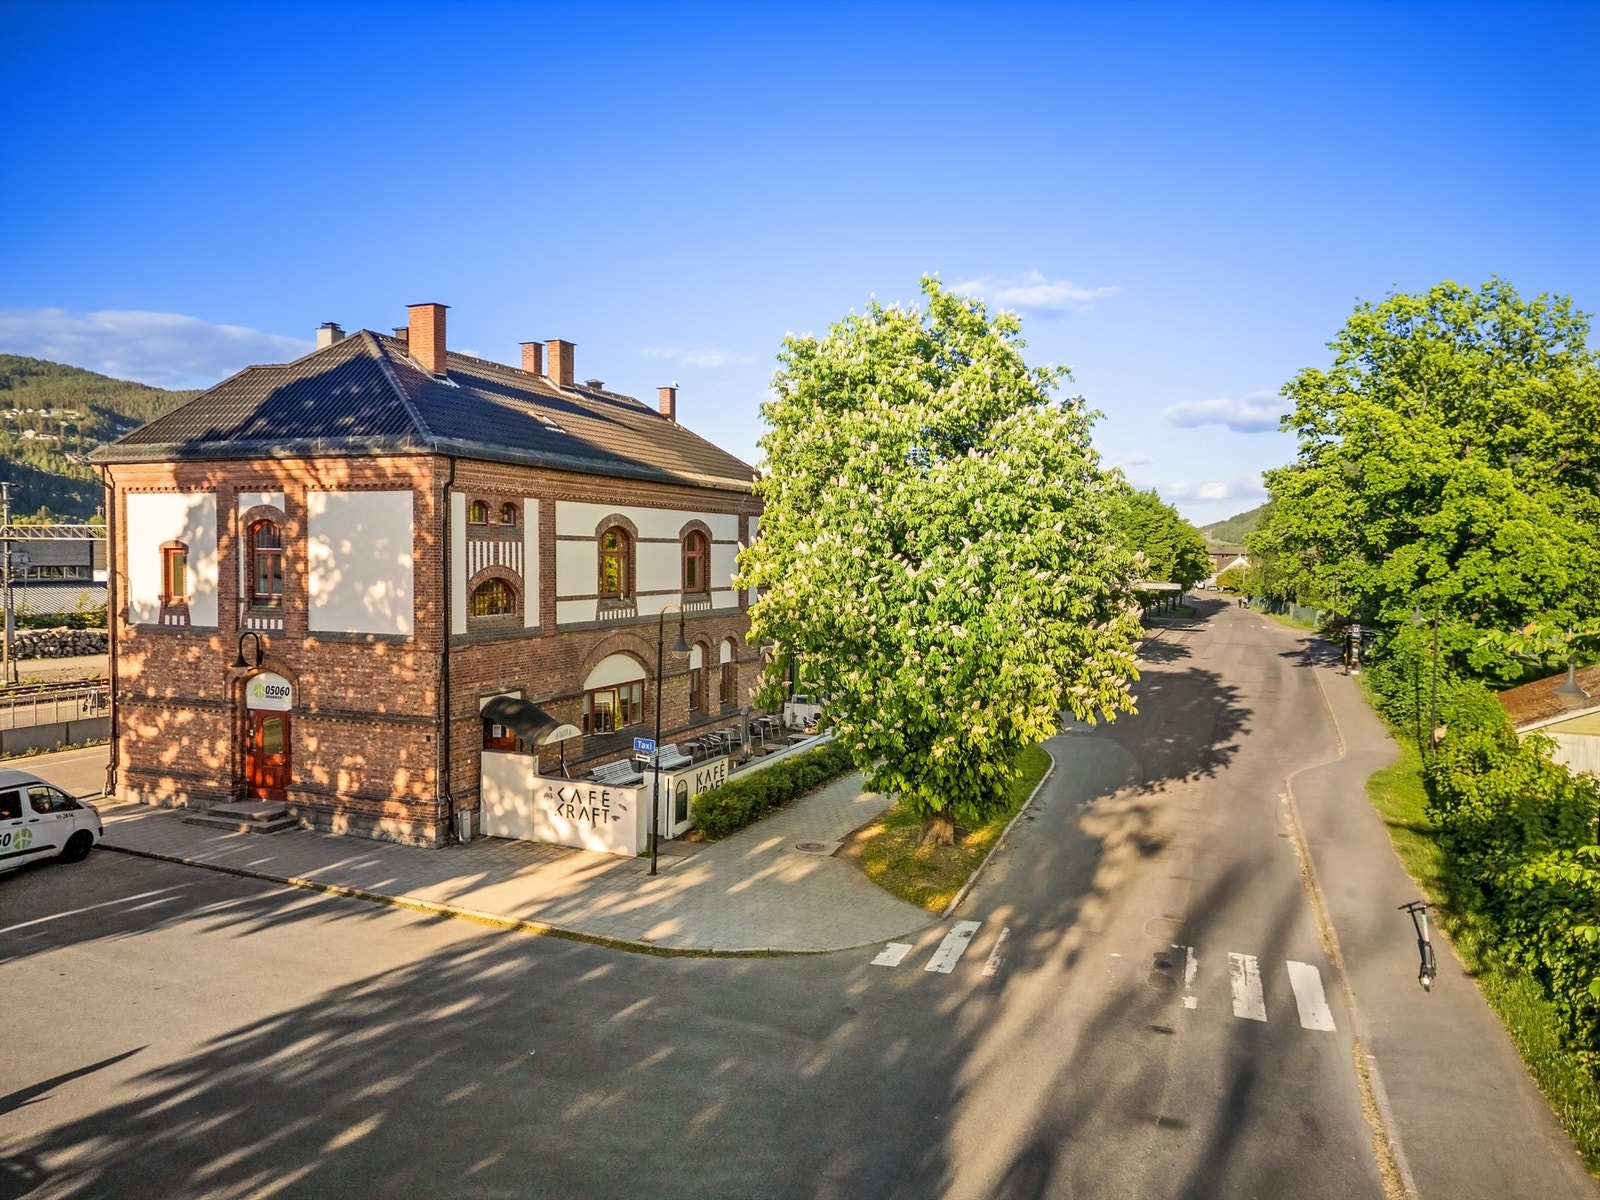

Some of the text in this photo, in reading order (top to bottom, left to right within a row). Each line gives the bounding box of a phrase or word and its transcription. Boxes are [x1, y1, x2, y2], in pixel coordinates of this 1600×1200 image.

[265, 685, 290, 696] 05060
[637, 740, 653, 750] Taxi
[696, 760, 725, 786] KAFÉ
[0, 833, 11, 847] 0
